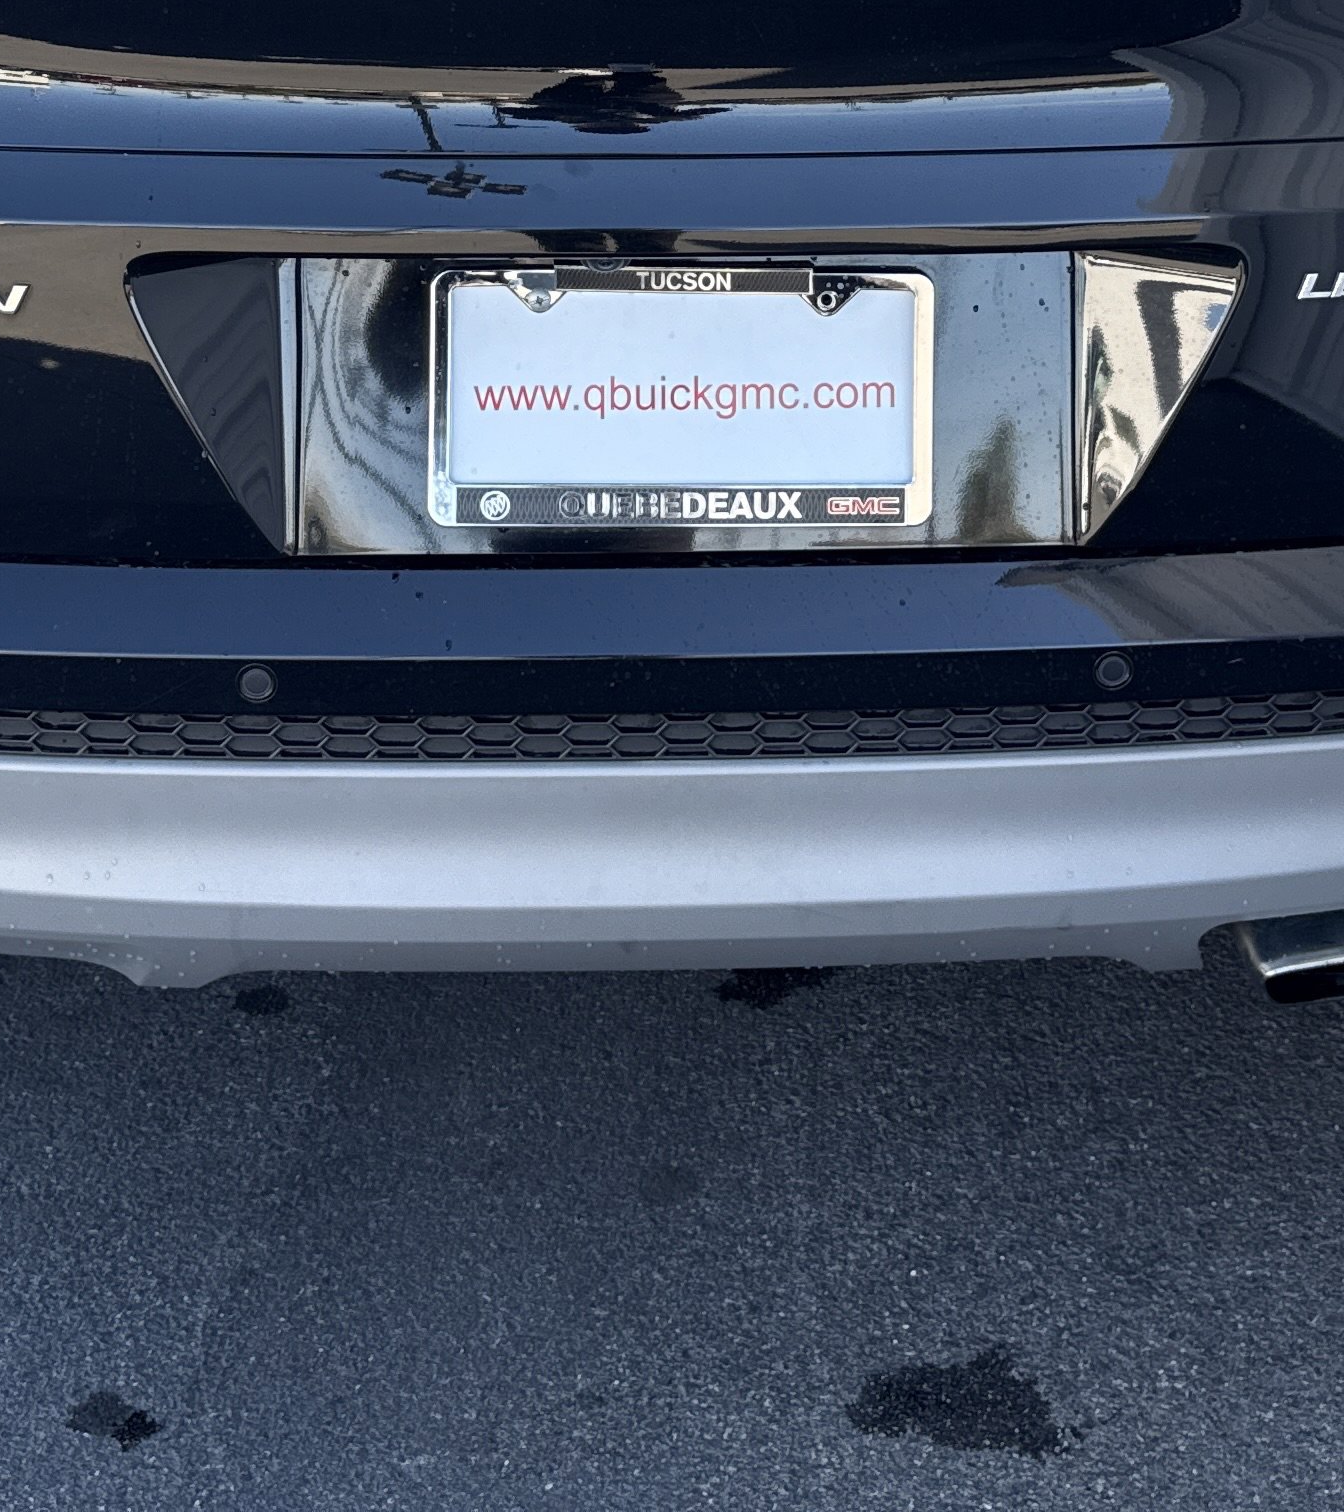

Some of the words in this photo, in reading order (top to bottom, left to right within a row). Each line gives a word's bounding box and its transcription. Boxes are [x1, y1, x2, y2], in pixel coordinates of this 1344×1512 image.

[636, 271, 733, 292] TUCSON
[473, 375, 896, 420] www.qbuickgmc.com
[558, 491, 803, 520] QUEBEDEAUX
[826, 496, 901, 516] GMC
